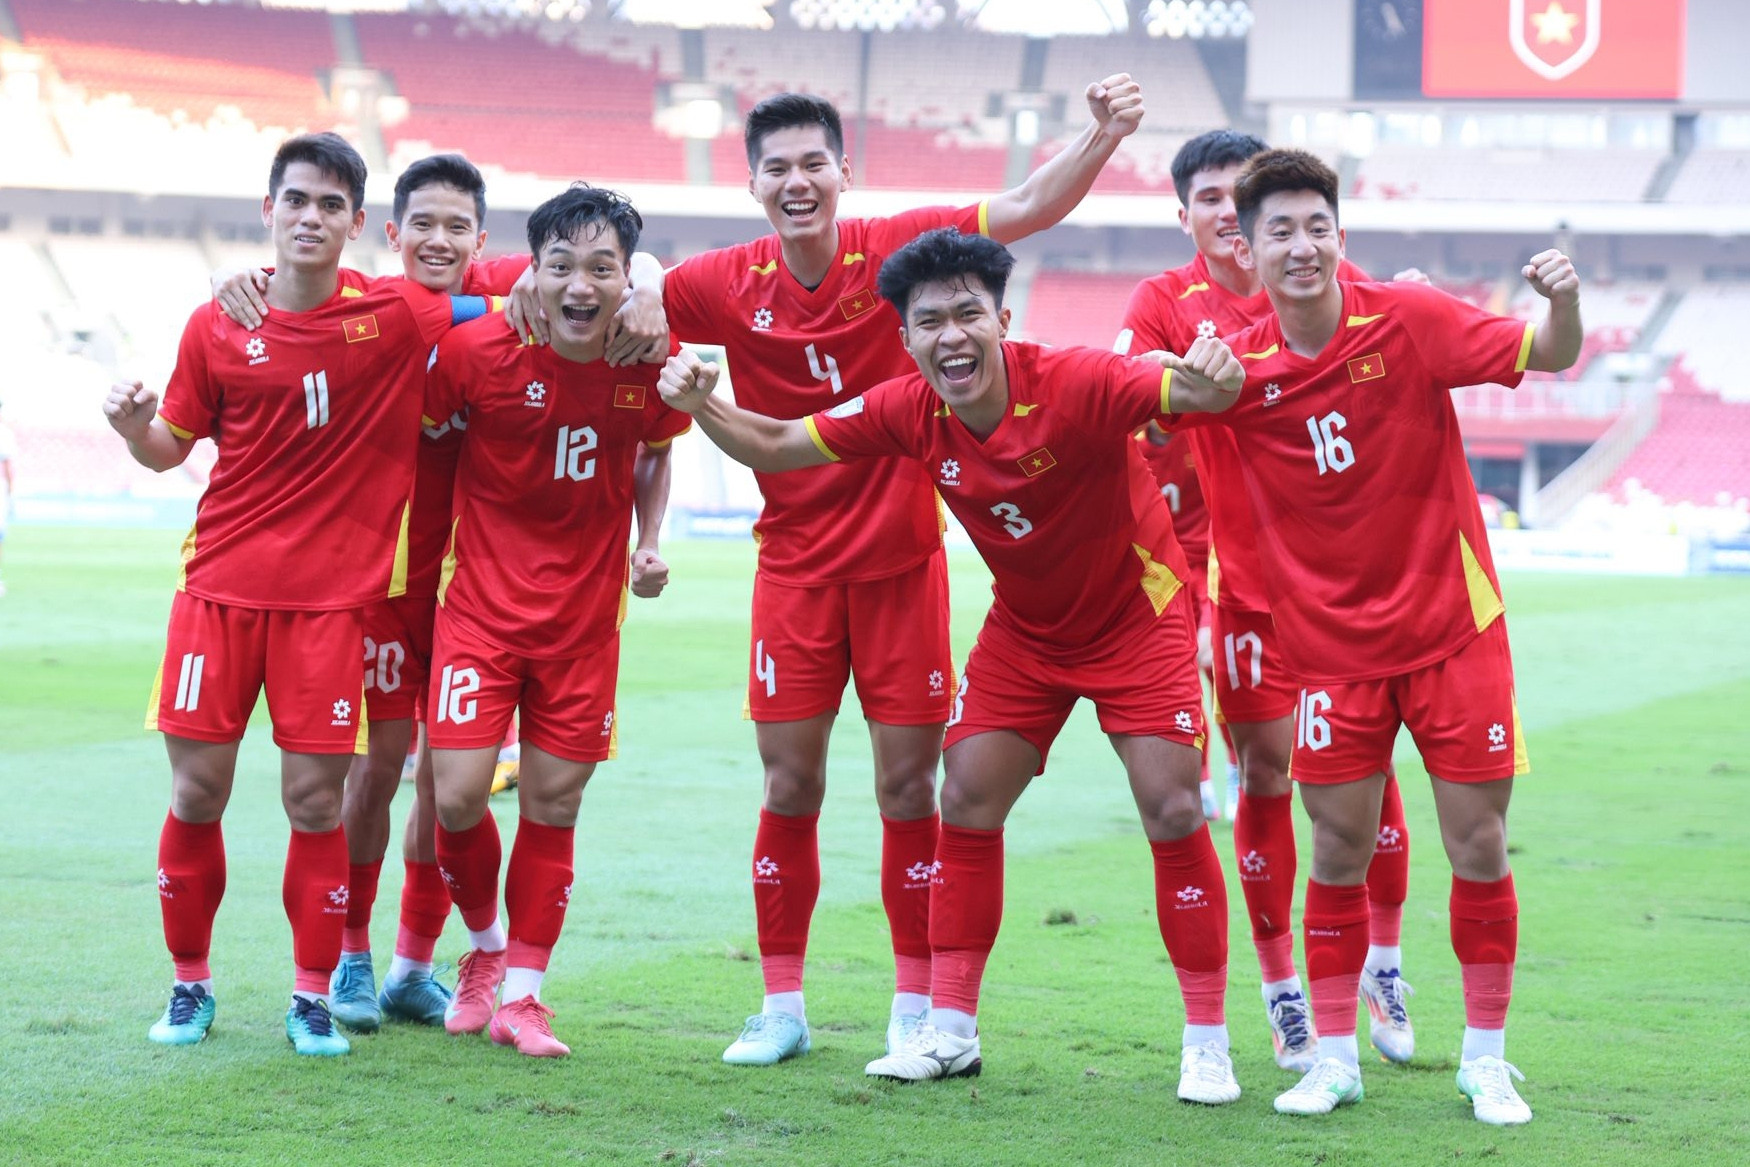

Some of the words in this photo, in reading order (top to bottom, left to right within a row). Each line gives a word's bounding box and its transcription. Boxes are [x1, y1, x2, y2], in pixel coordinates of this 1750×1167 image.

[804, 342, 843, 395] 4
[302, 369, 329, 429] 11
[553, 425, 598, 482] 12
[1305, 410, 1356, 476] 16
[990, 502, 1033, 540] 3
[173, 652, 205, 713] 11
[755, 638, 777, 698] 4
[1224, 630, 1263, 691] 17
[436, 664, 481, 726] 12
[1297, 688, 1333, 752] 16
